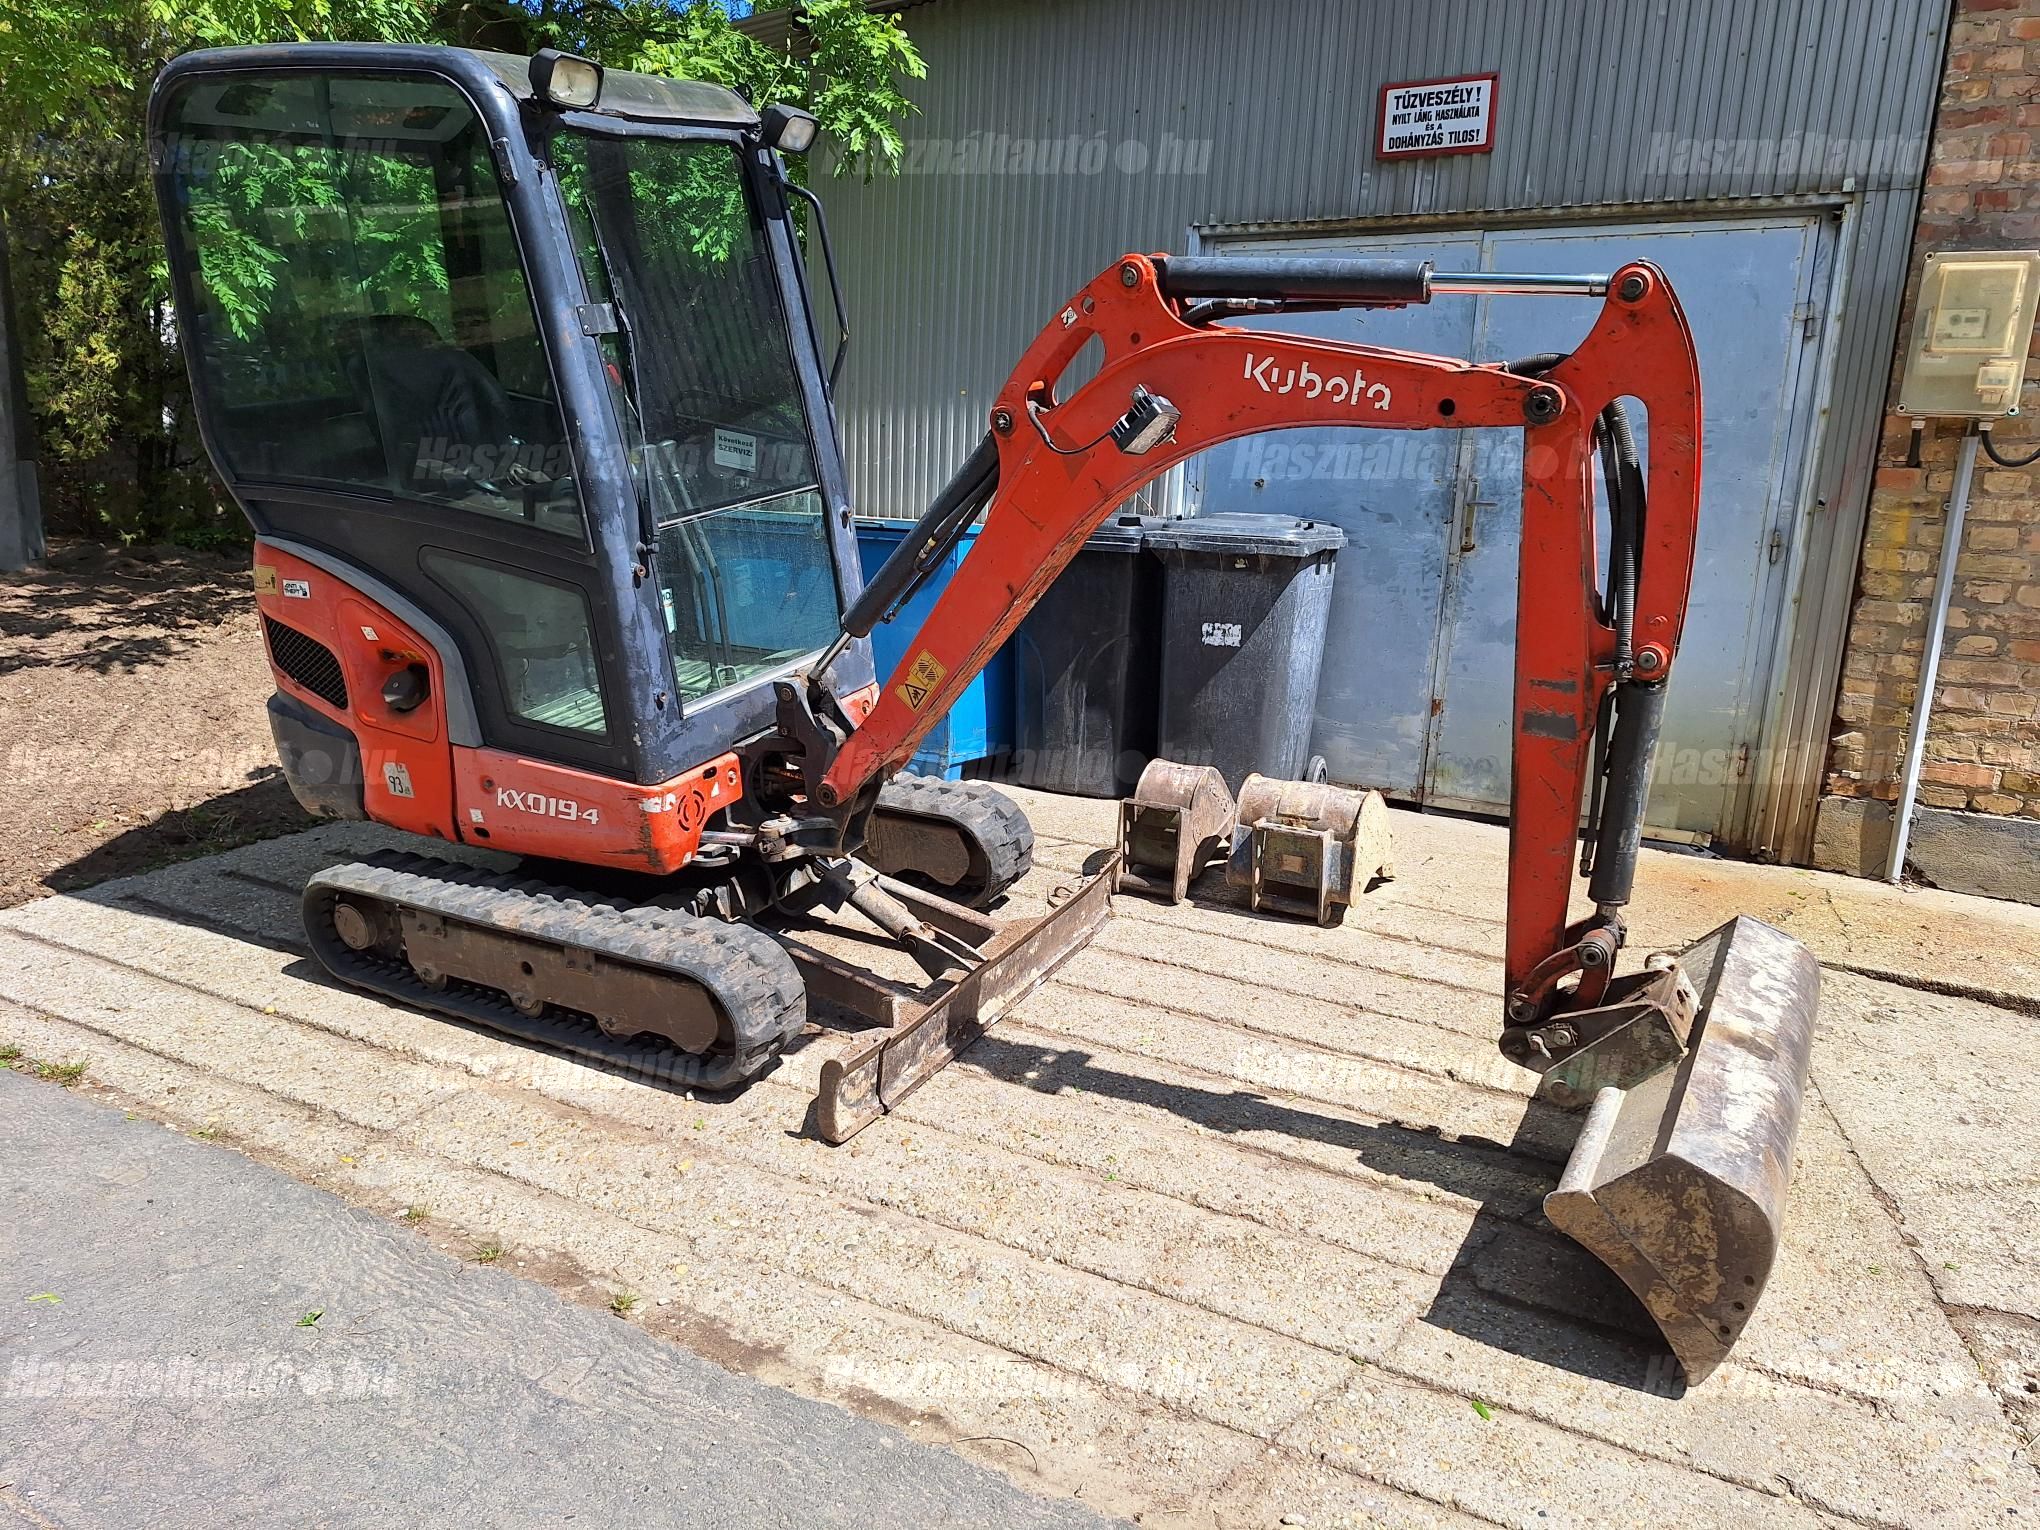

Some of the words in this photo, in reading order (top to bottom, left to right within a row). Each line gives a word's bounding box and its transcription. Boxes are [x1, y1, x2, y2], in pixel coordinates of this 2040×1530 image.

[1392, 113, 1412, 125] NYILT
[1414, 109, 1433, 123] LÁNG
[1435, 105, 1480, 121] HASZNÁLATA
[1389, 132, 1444, 150] DOHÁNYZÁS
[1448, 129, 1480, 144] TILOS!
[1243, 352, 1392, 411] Kubota
[718, 444, 753, 457] SZERVIZ:
[388, 775, 404, 794] 93
[496, 787, 600, 825] KX019-4
